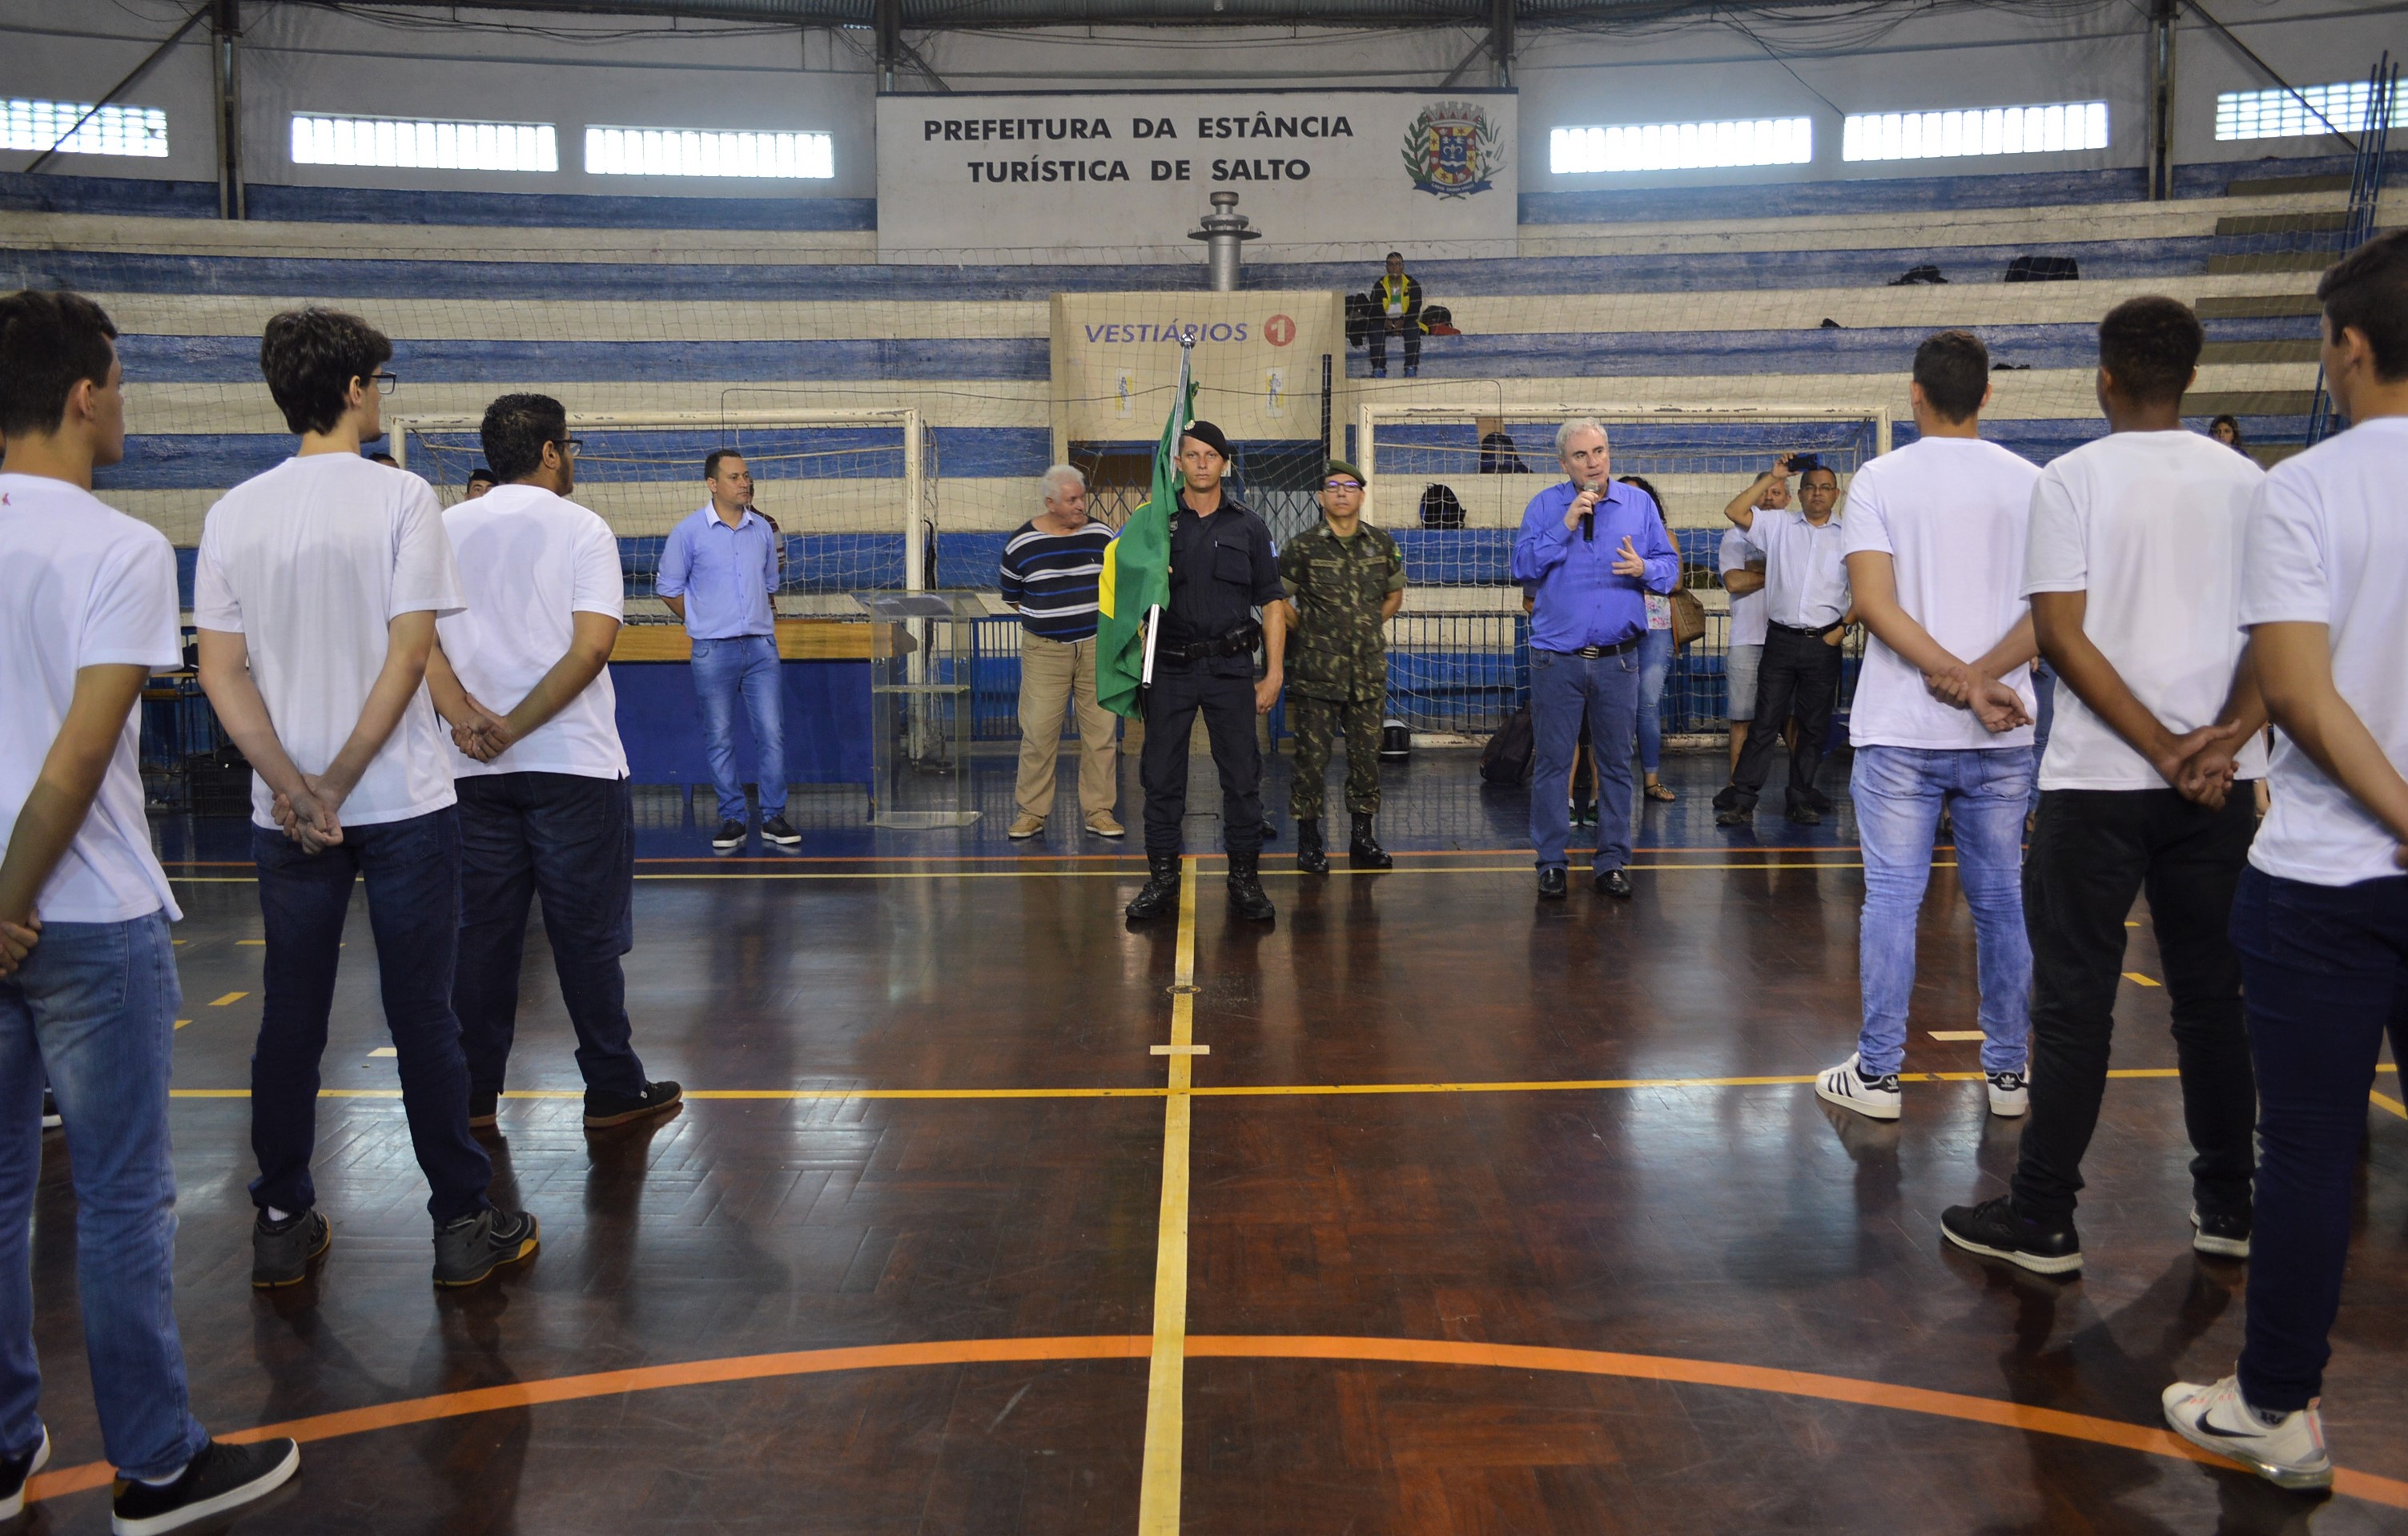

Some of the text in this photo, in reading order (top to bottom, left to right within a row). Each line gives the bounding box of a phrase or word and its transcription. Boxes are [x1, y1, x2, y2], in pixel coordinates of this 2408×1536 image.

[924, 111, 1353, 141] PREFEITURA DA ESTÂNCIA
[967, 155, 1311, 183] TURÍSTICA DE SALTO
[1270, 321, 1285, 343] 1
